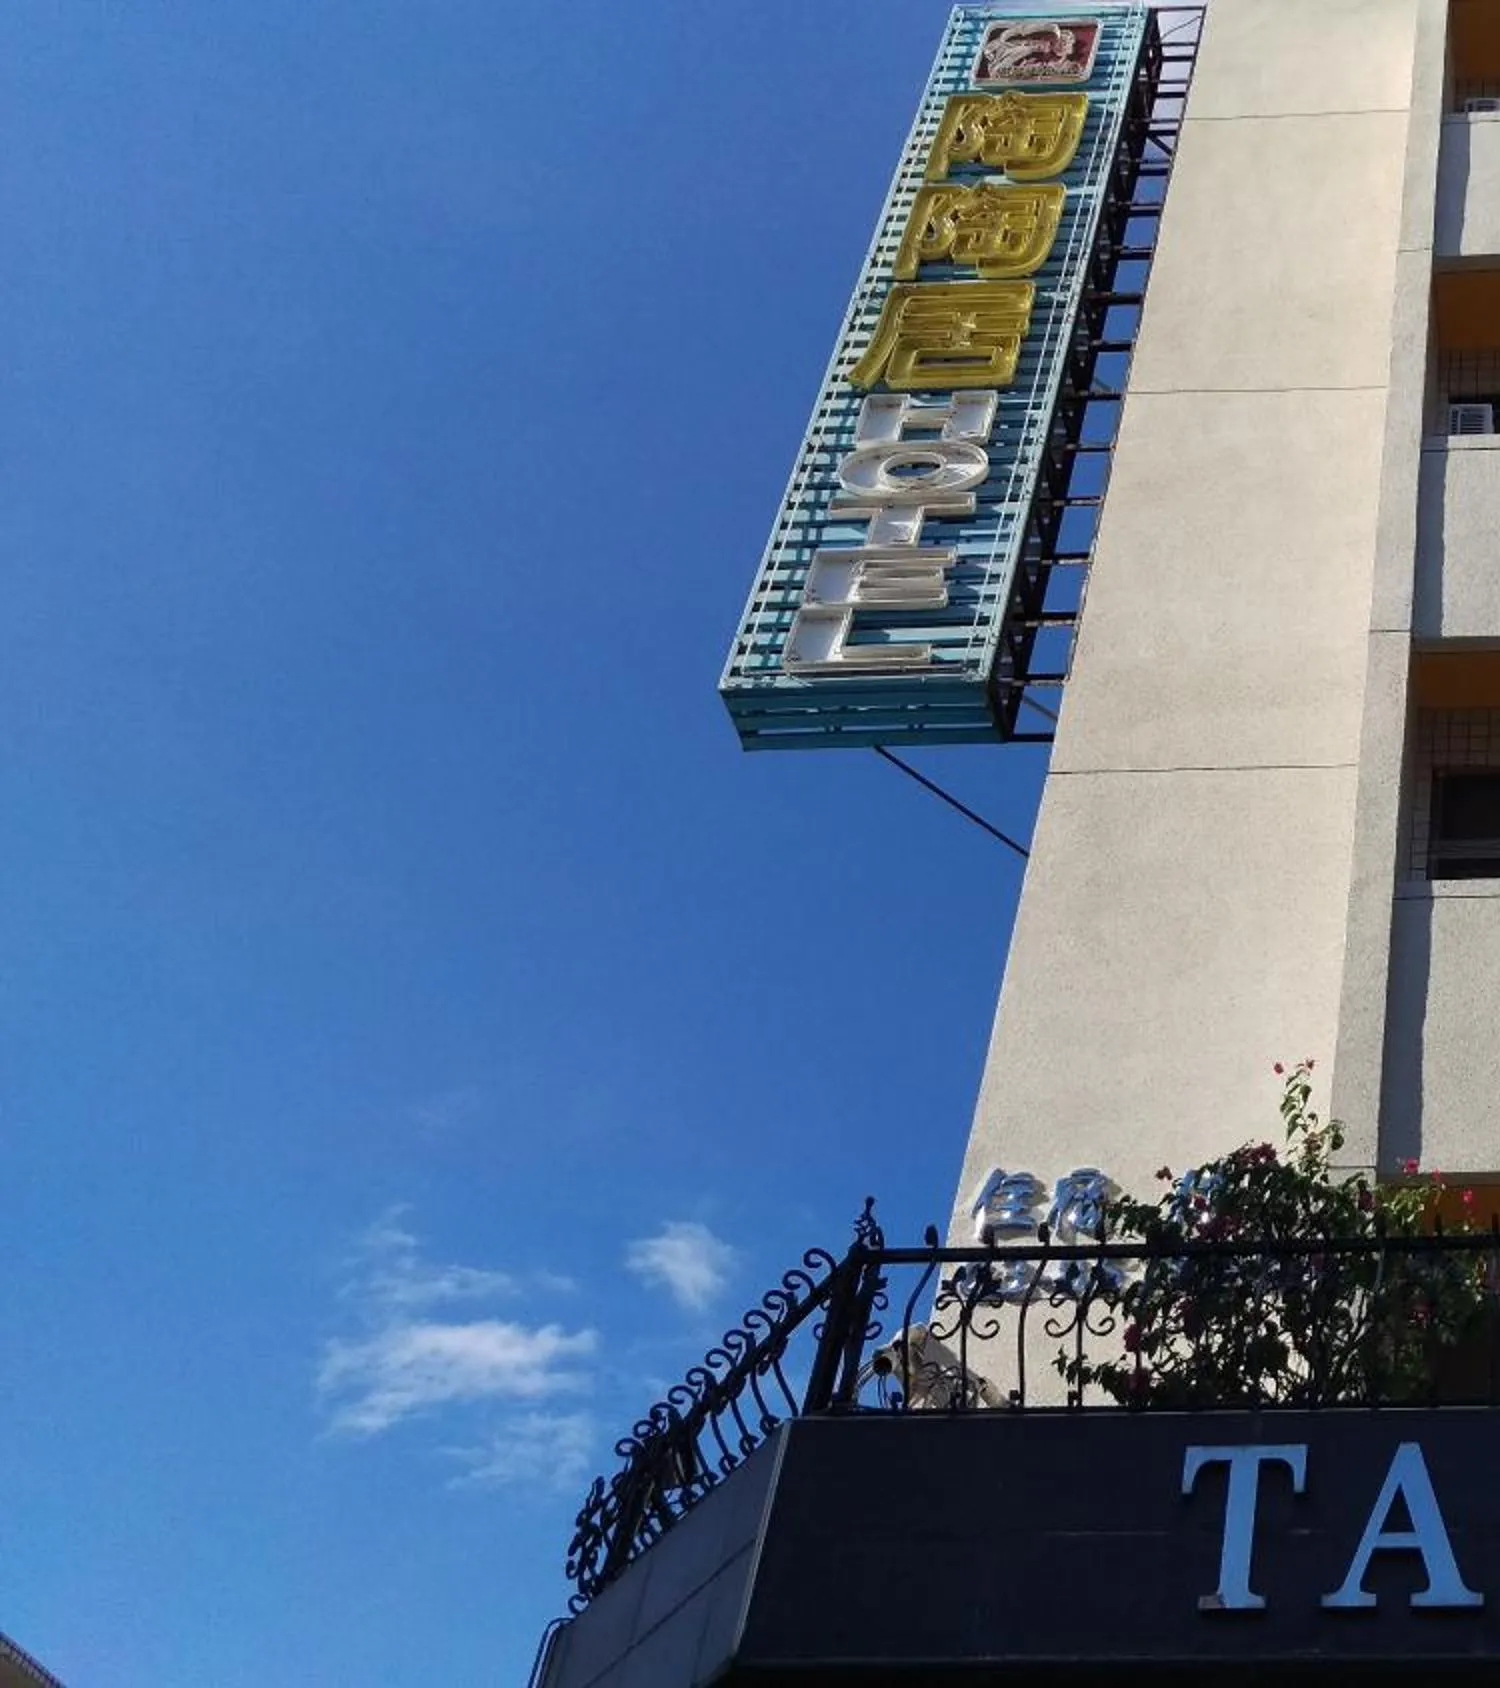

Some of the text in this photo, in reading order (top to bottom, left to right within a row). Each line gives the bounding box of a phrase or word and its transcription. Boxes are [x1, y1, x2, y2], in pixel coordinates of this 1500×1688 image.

[849, 91, 1088, 389] 陶陶居
[782, 390, 998, 673] HOTEL
